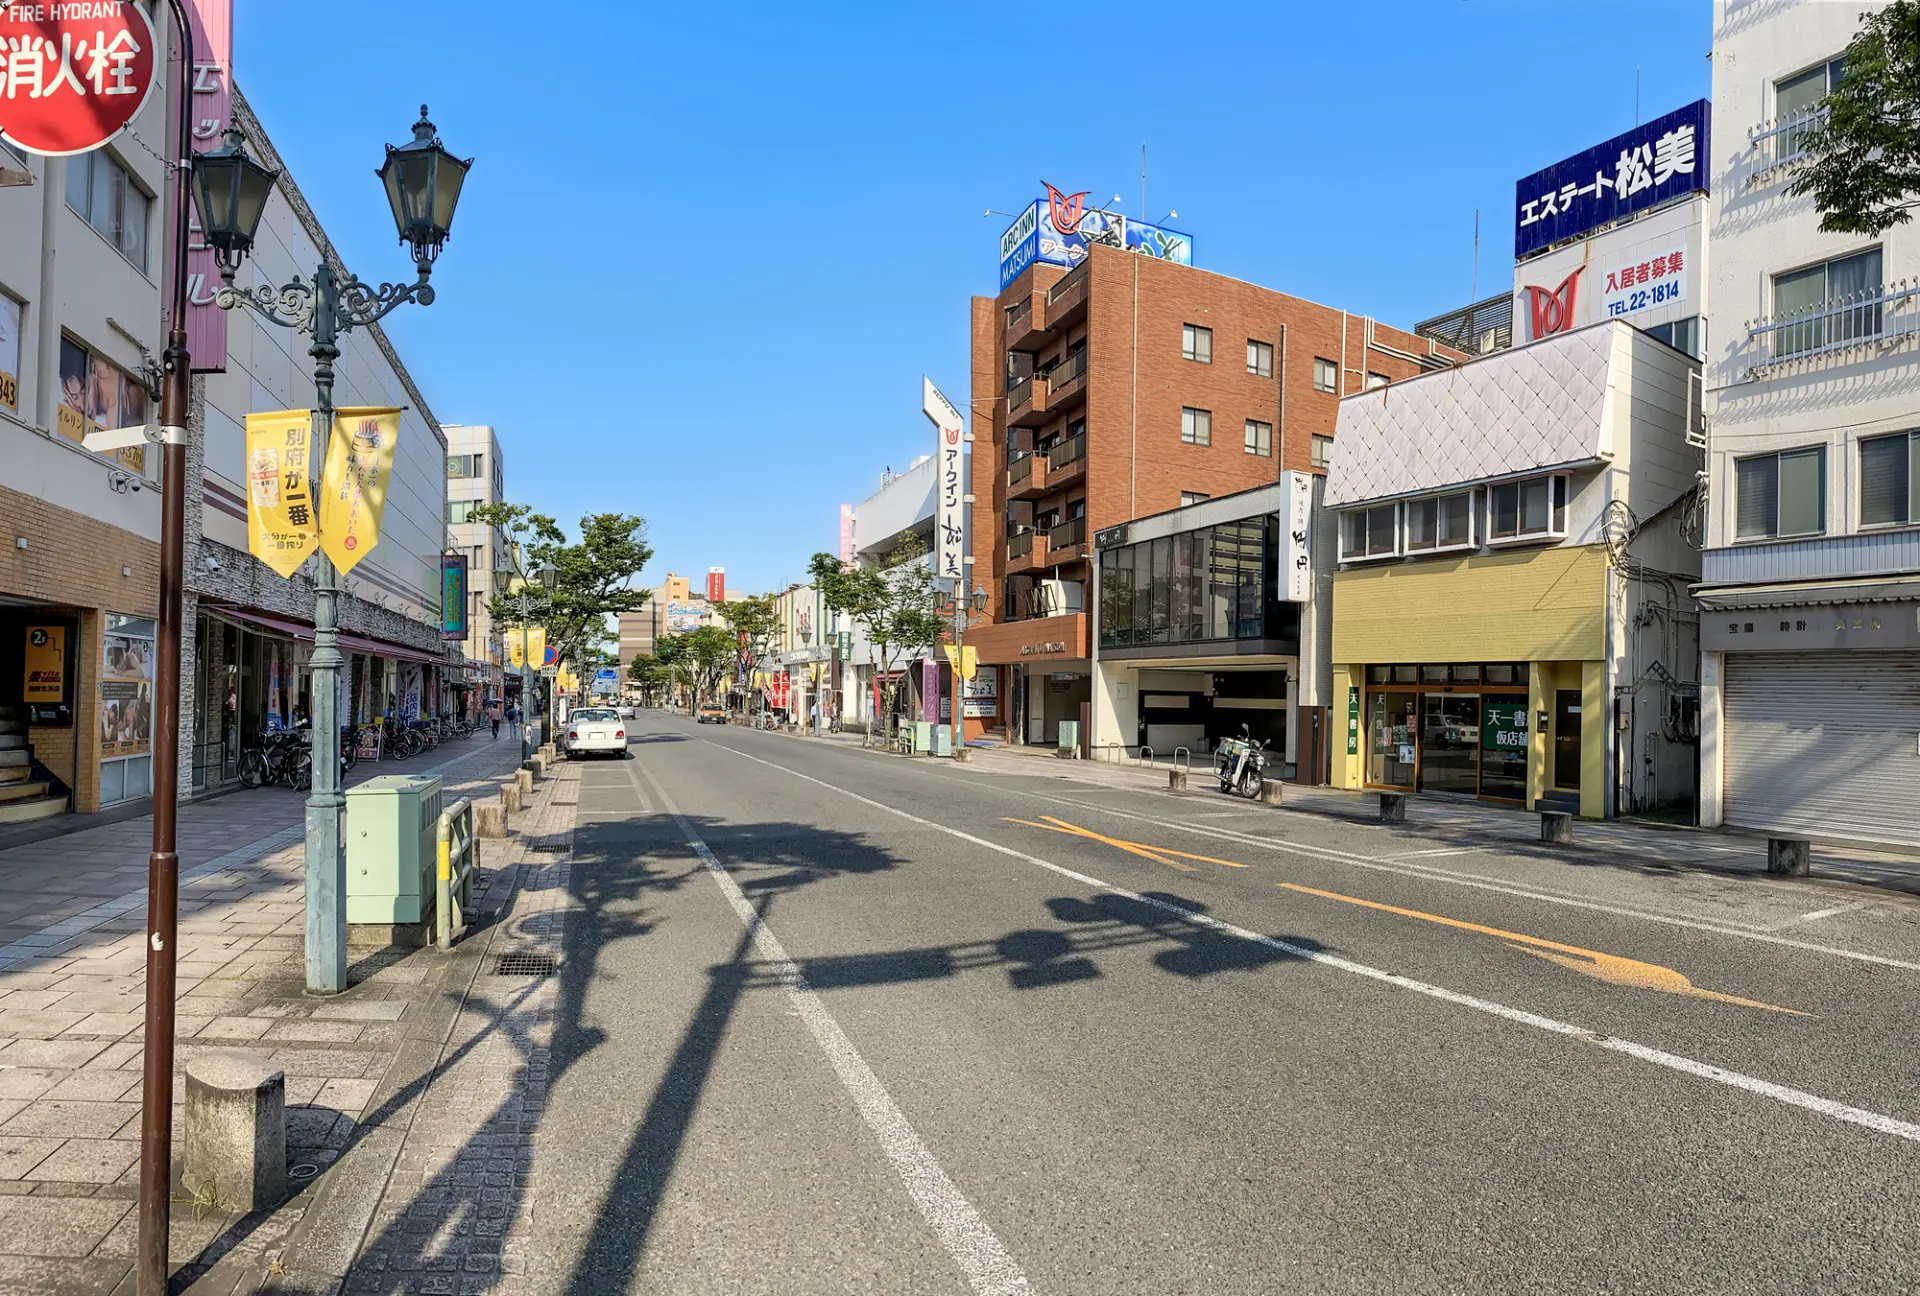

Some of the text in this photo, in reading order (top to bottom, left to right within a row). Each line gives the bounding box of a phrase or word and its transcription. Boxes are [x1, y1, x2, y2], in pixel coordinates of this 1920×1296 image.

[9, 1, 124, 23] FIRE HYDRANT
[0, 29, 141, 99] 消火栓
[1003, 208, 1034, 258] ARC INN
[1001, 235, 1036, 286] MATSUMI
[1605, 251, 1684, 295] 入居者募集
[1608, 280, 1680, 317] TEL 22-1814
[932, 389, 950, 409] BEPPU
[285, 428, 309, 526] 別府が一番
[946, 449, 957, 507] アークイン
[262, 532, 307, 541] 大分が一番
[267, 540, 304, 549] 一番搾り
[33, 631, 47, 645] 2F
[1348, 693, 1358, 748] 天一書房
[1488, 709, 1528, 727] 天一書
